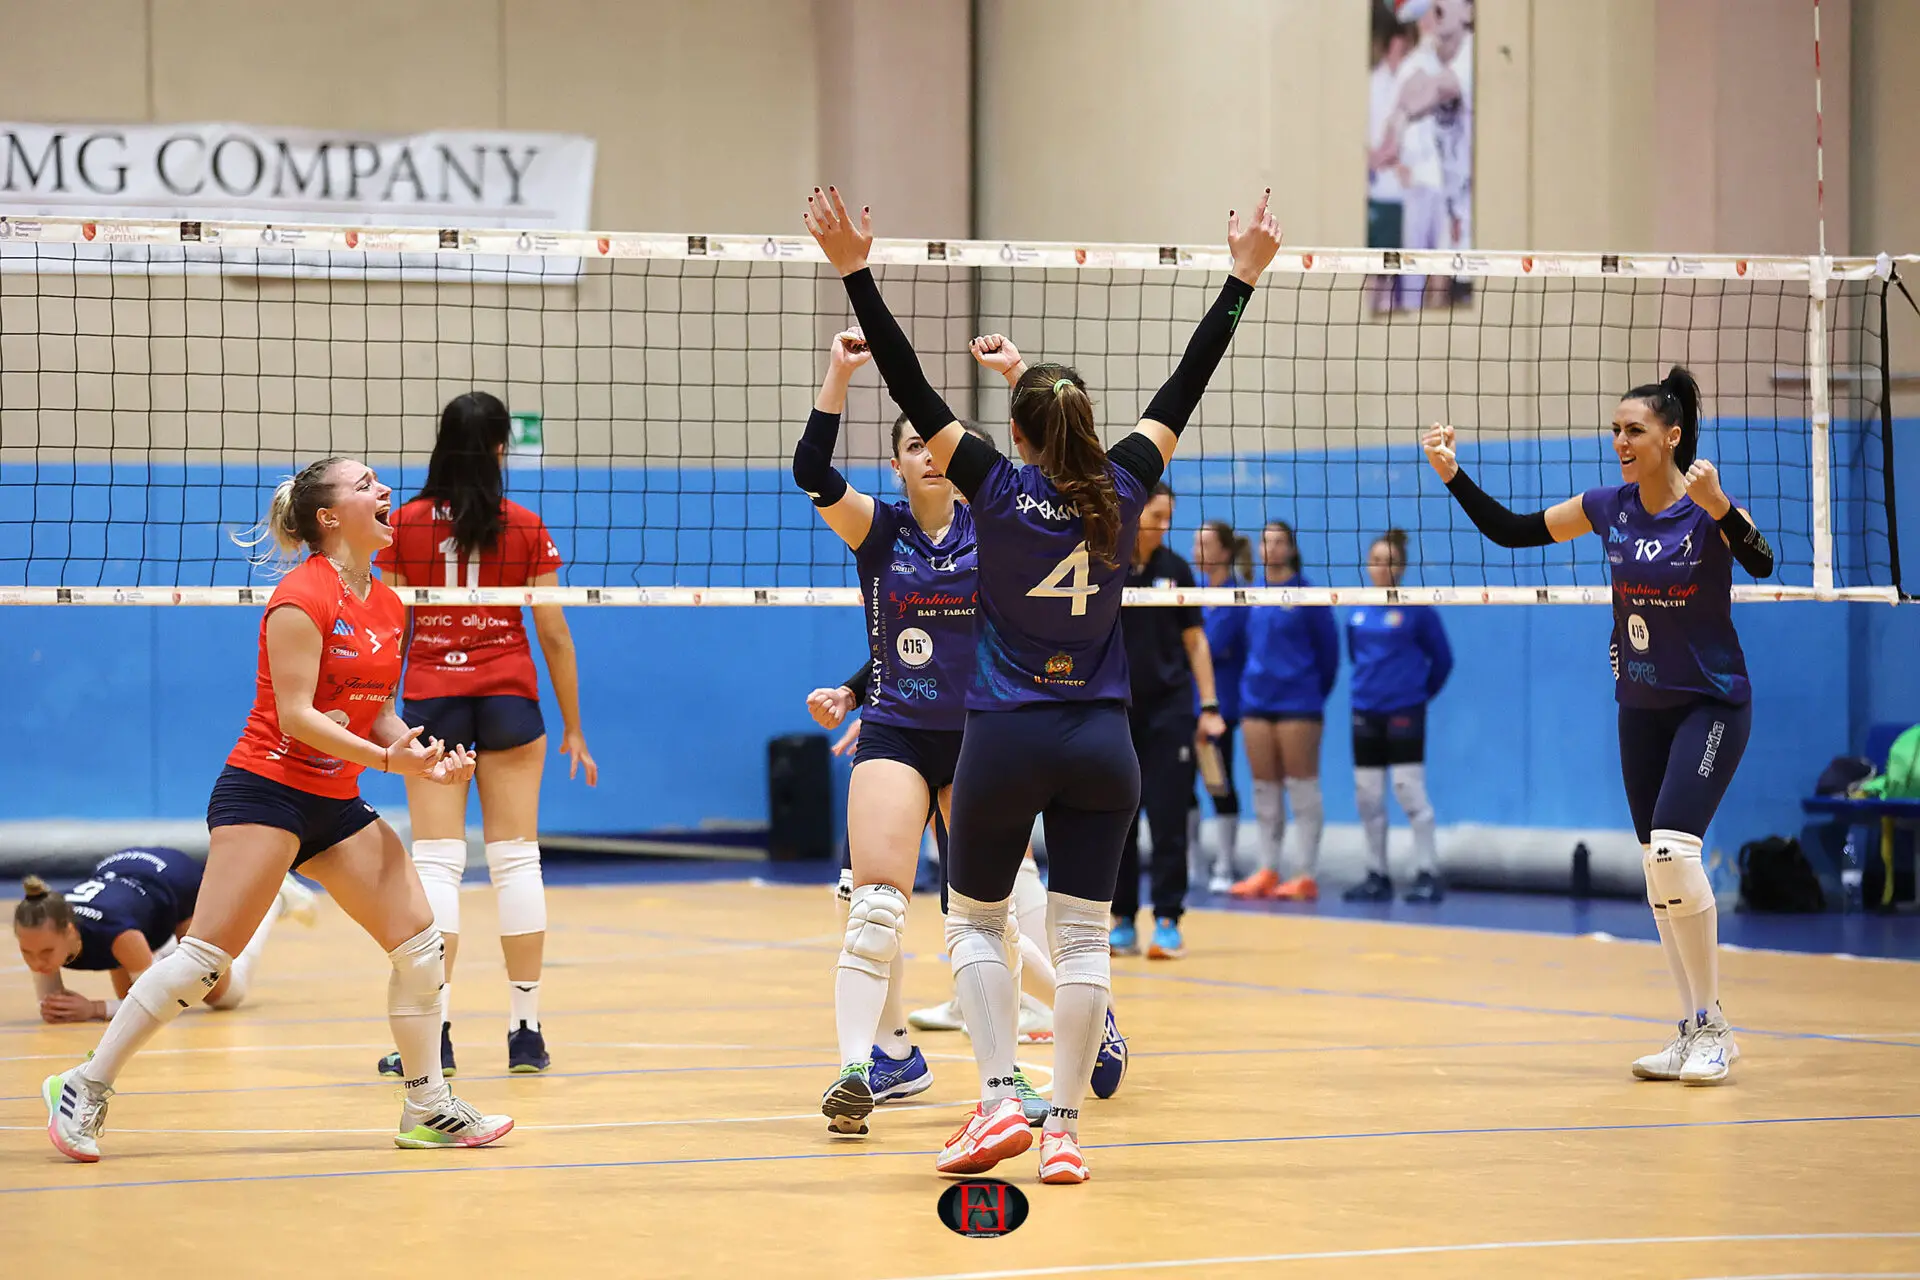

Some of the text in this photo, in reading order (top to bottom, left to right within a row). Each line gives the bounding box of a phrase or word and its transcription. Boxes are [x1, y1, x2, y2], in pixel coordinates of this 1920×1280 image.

[1, 131, 539, 205] MG COMPANY
[1634, 538, 1663, 561] 10
[1025, 540, 1100, 616] 4
[905, 591, 964, 605] Fashion
[917, 609, 937, 617] BAR
[943, 607, 976, 616] TABACC
[902, 638, 927, 654] 475°
